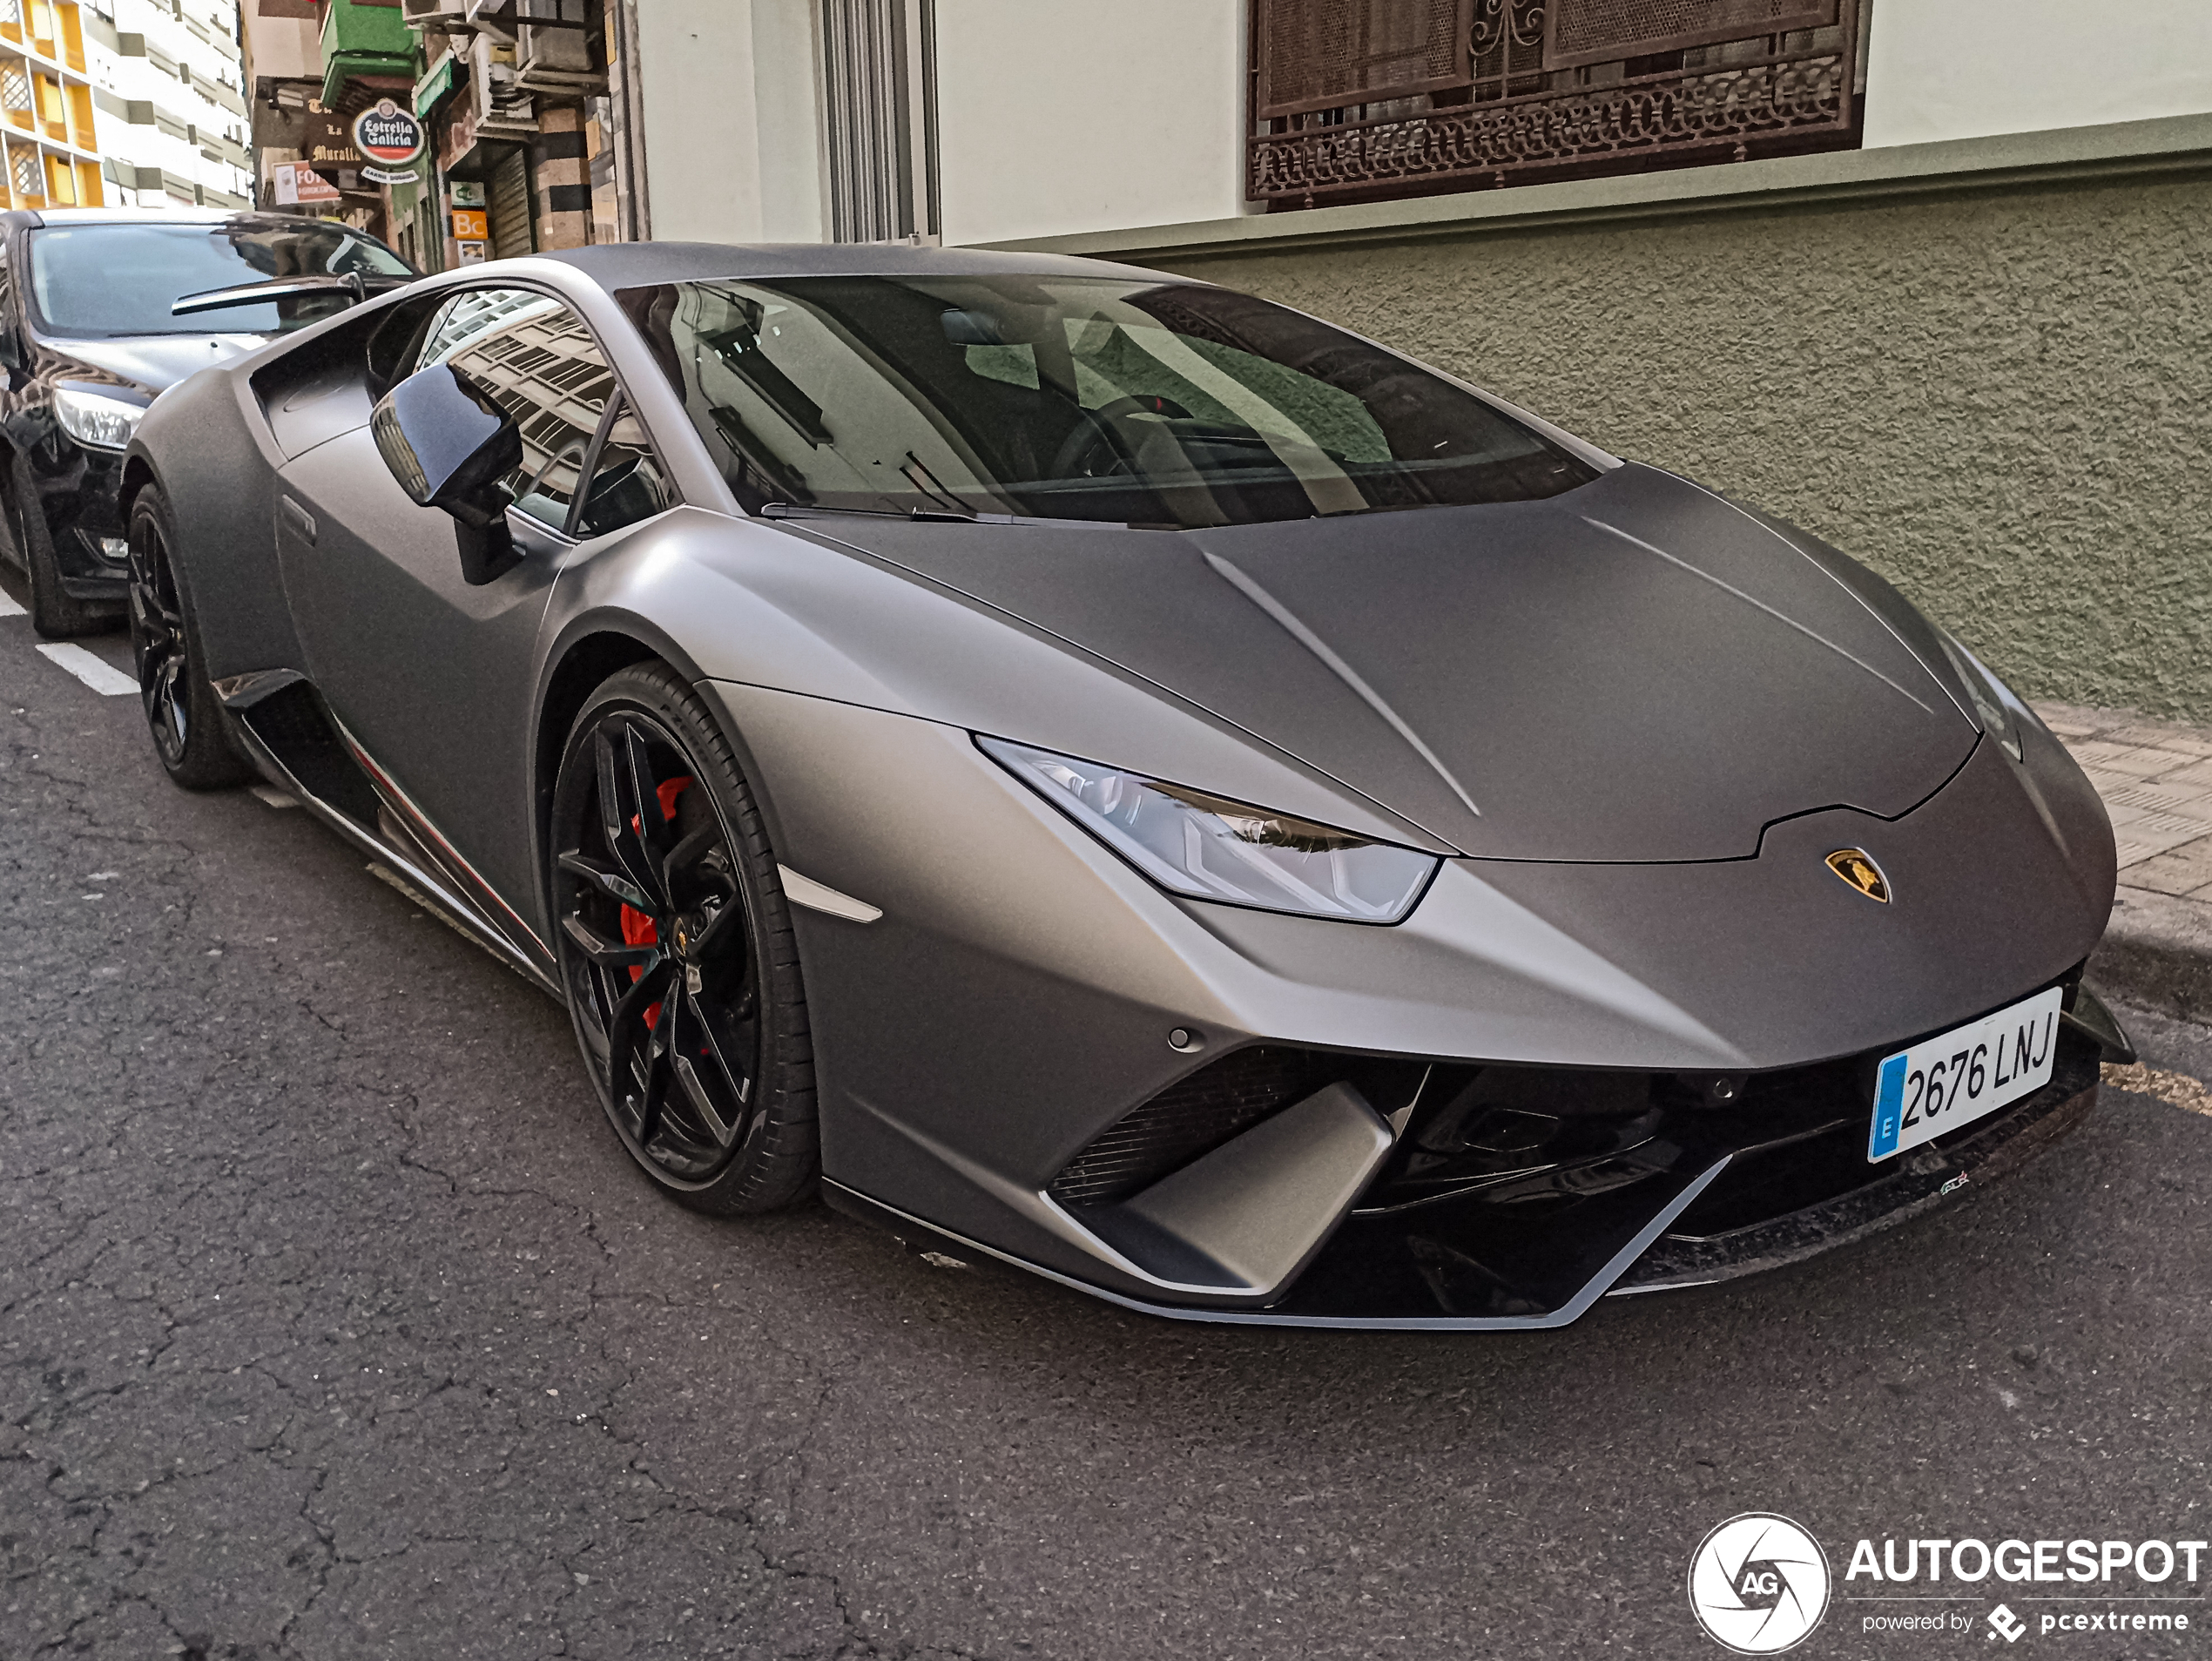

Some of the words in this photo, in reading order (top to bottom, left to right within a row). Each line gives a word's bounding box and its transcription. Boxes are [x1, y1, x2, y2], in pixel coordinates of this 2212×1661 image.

[365, 119, 413, 133] Estrella
[368, 132, 411, 145] Galicia
[1901, 1043, 1987, 1130] 2676
[1994, 1012, 2053, 1089] LNJ
[1881, 1116, 1893, 1139] E
